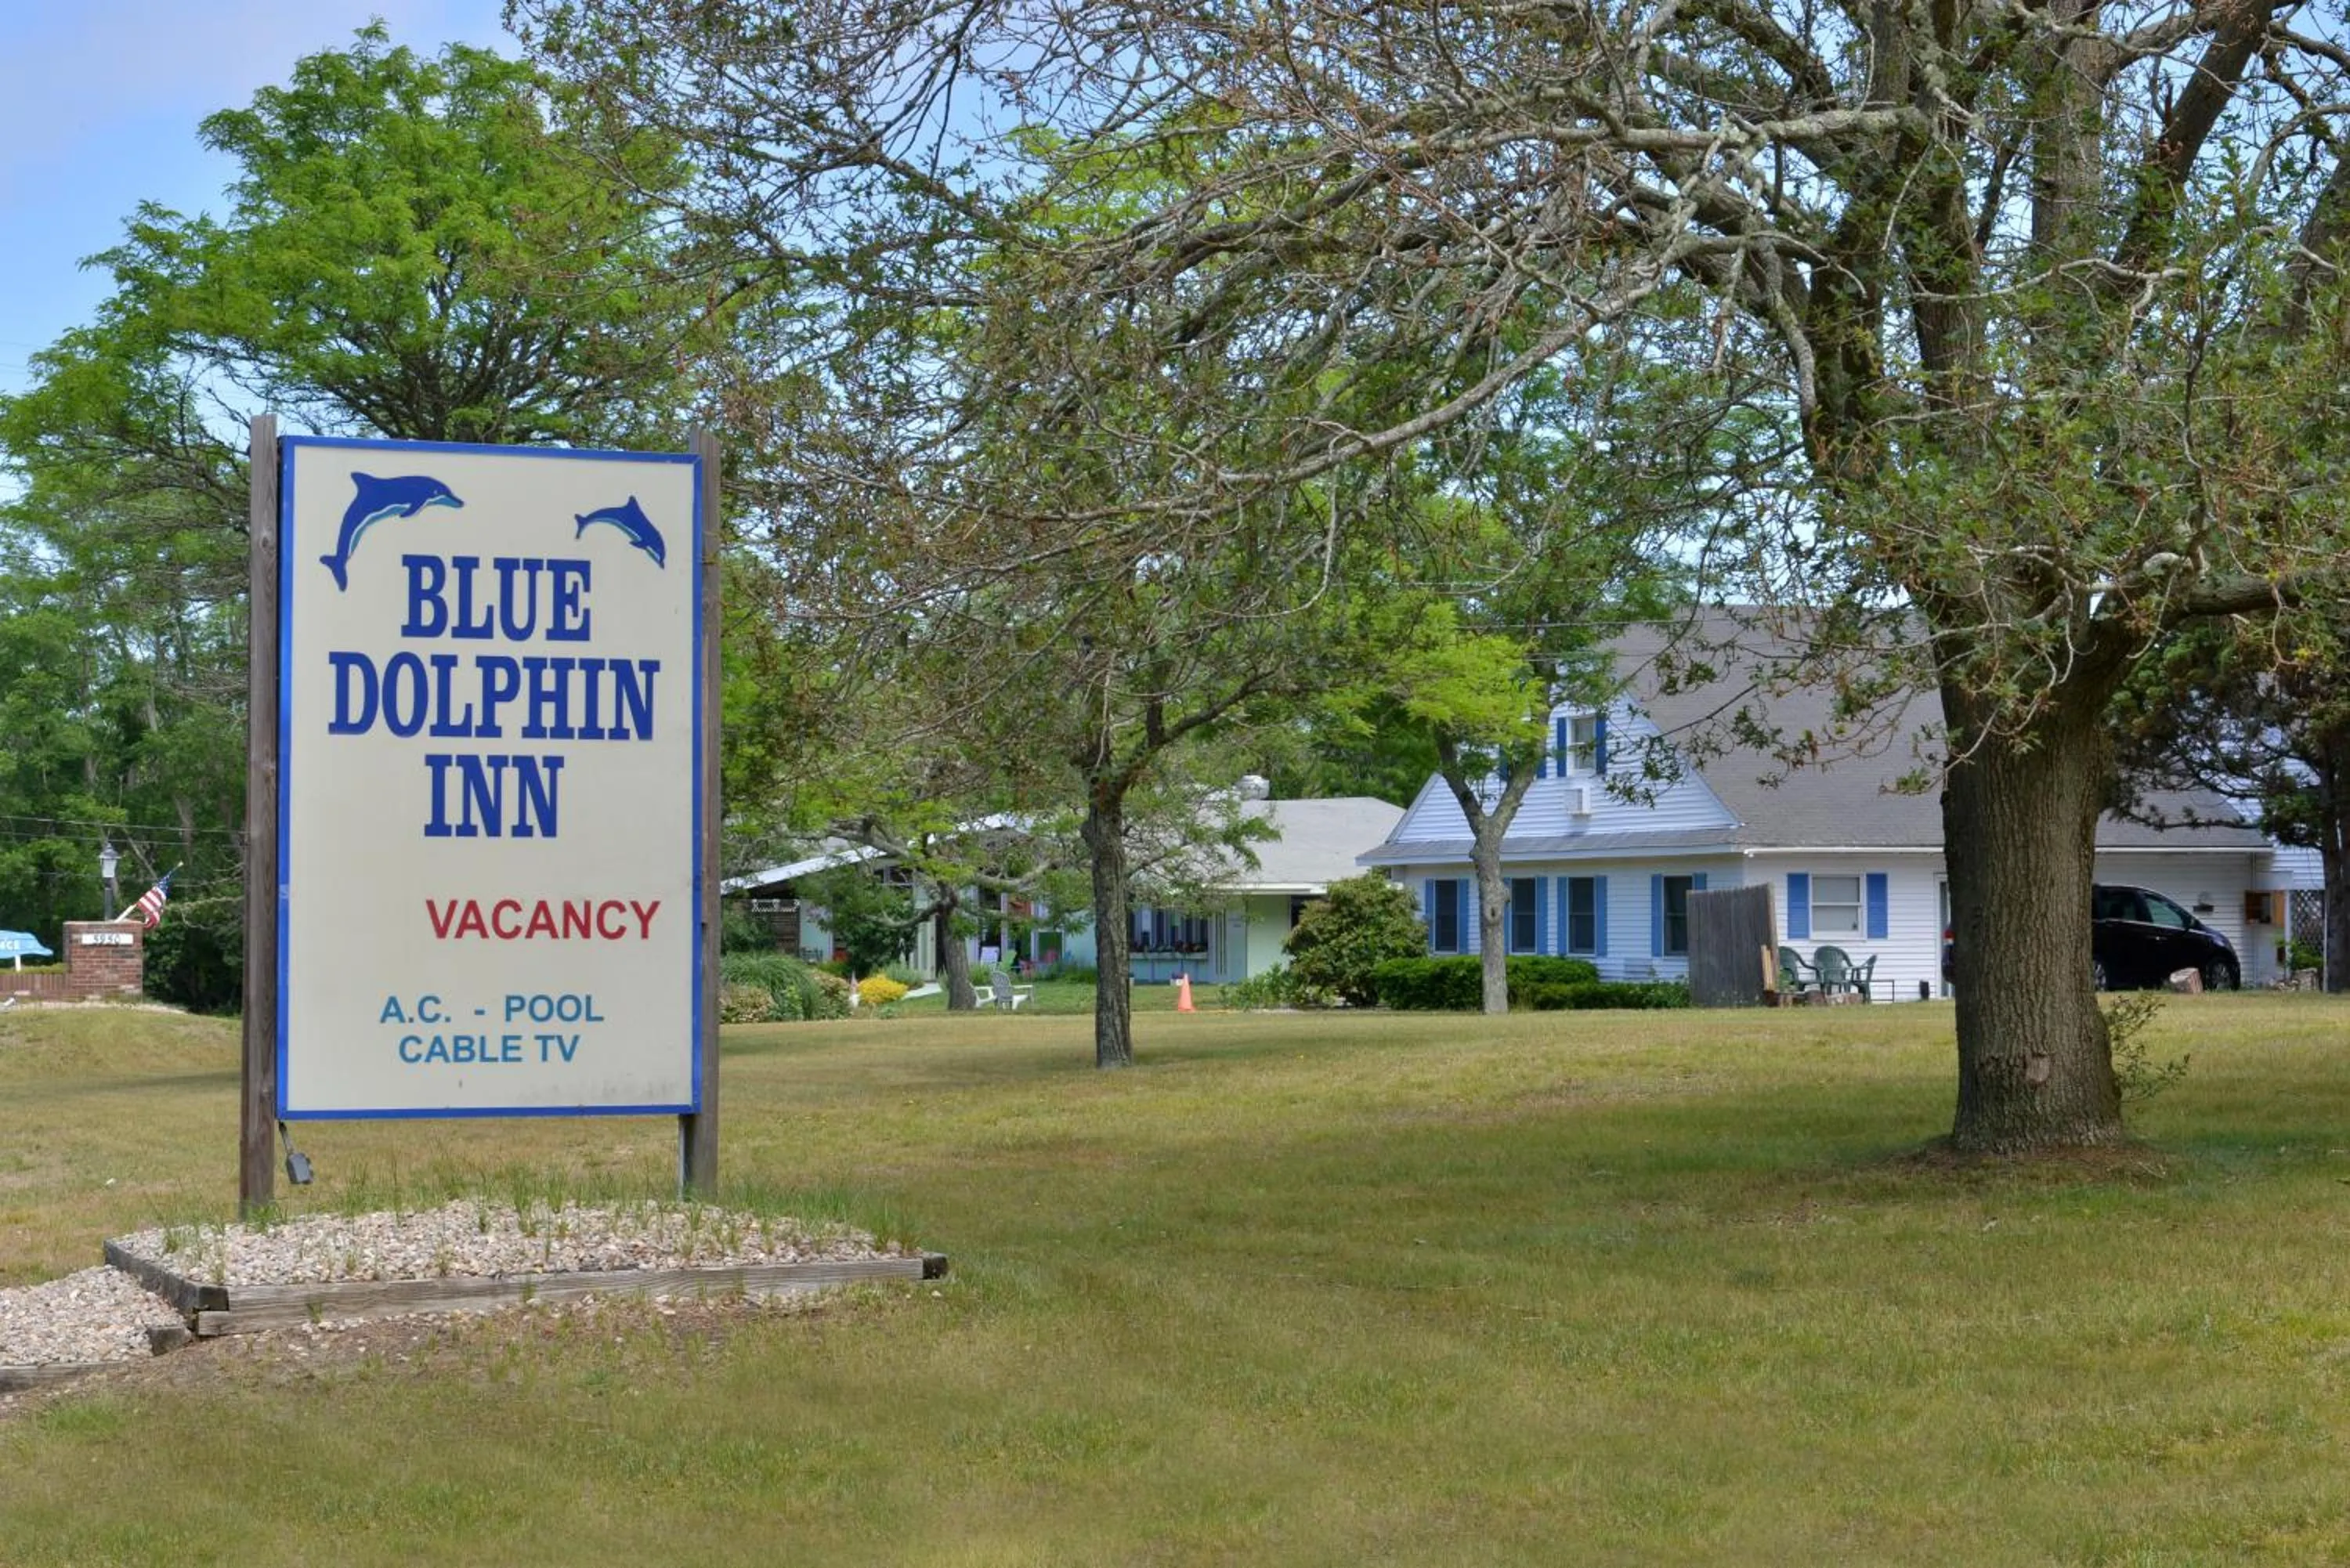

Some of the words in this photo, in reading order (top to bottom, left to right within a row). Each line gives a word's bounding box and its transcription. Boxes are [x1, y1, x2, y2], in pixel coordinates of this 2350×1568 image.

[400, 554, 591, 642] BLUE
[328, 651, 661, 740] DOLPHIN
[425, 754, 566, 838] INN
[425, 899, 660, 941] VACANCY
[379, 995, 452, 1024] A.C.
[504, 995, 605, 1023] POOL
[398, 1034, 522, 1064] CABLE
[534, 1035, 580, 1062] TV
